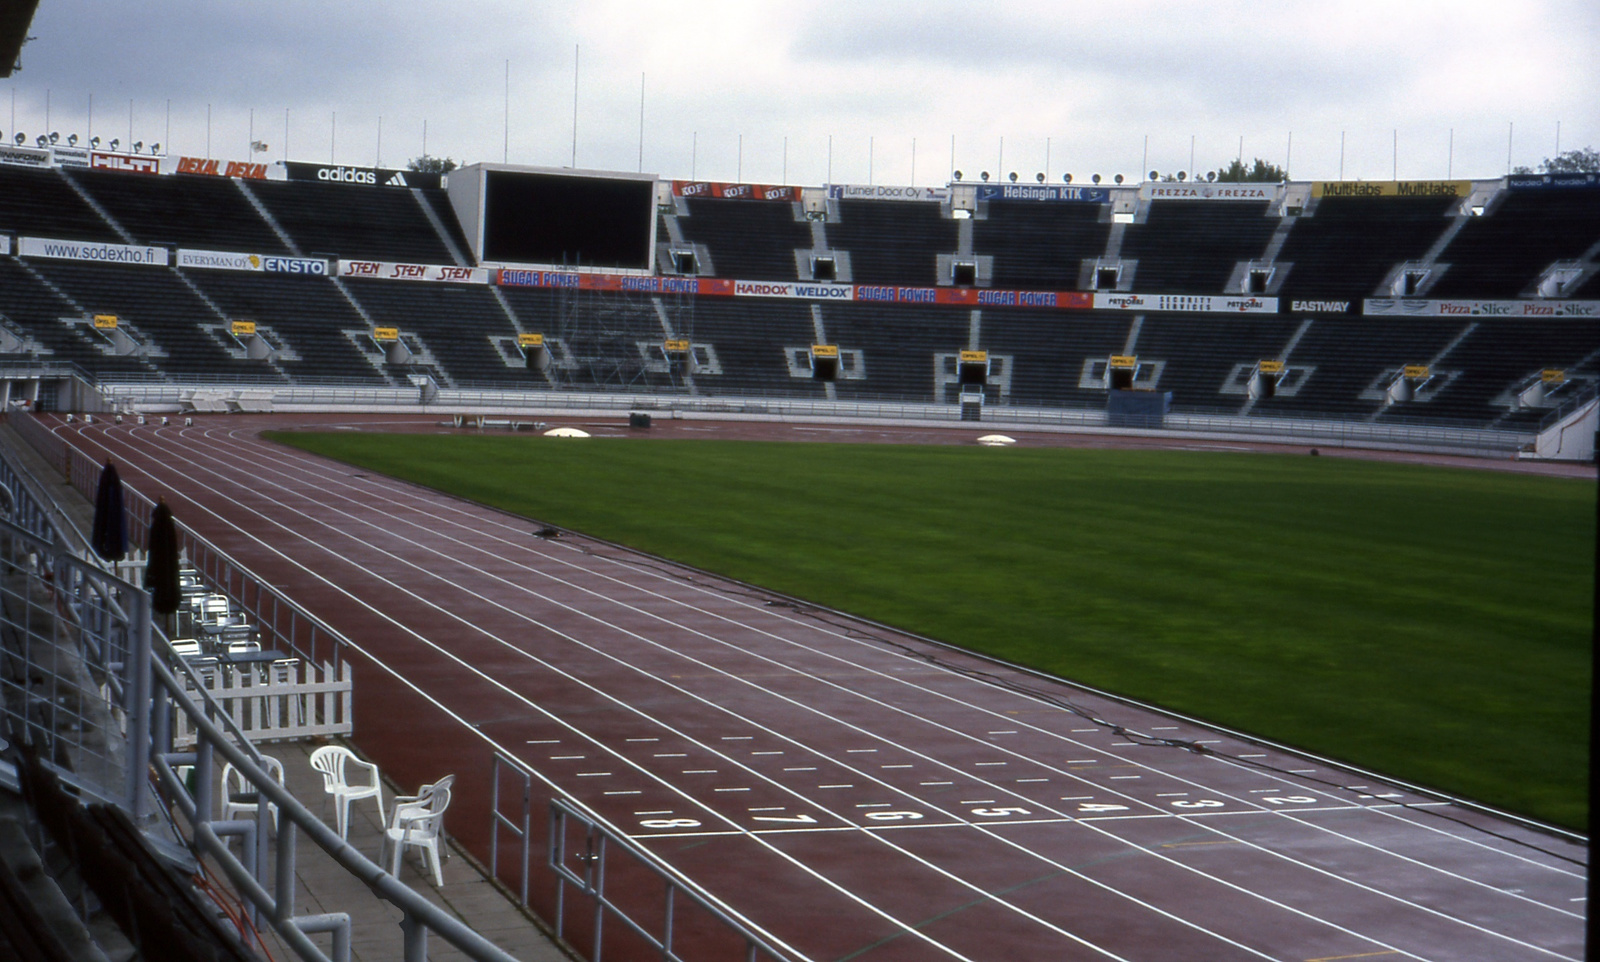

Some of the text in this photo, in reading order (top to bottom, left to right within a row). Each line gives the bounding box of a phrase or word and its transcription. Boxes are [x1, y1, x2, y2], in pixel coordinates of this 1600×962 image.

[93, 155, 158, 172] HILTI
[176, 156, 268, 180] DEXAL DEXAL
[318, 167, 376, 184] adidas
[845, 184, 875, 195] Turner
[877, 186, 903, 196] Door
[905, 187, 921, 198] Oy
[1003, 186, 1057, 201] Helsingin
[1060, 187, 1083, 199] KTK
[1151, 188, 1198, 197] FREZZA
[1217, 188, 1265, 198] FREZZA
[1323, 182, 1382, 196] Multi-tabs
[1397, 181, 1457, 195] Multi-tabs
[44, 242, 154, 263] www.sodexho.fi
[182, 254, 233, 268] EVERYMAN
[265, 258, 324, 274] ENSTO
[345, 262, 472, 281] STEN STEN STEN
[502, 270, 540, 286] SUGAR
[543, 272, 580, 288] POWER
[621, 277, 658, 292] SUGAR
[662, 279, 699, 293] POWER
[858, 286, 895, 301] SUGAR
[899, 288, 936, 302] POWER
[977, 290, 1016, 305] SUGAR
[1019, 291, 1057, 306] POWER
[1291, 300, 1350, 312] EASTWAY
[1440, 303, 1471, 315] Pizza
[1481, 303, 1510, 315] Slice
[1523, 303, 1593, 315] Pizza Slice
[1171, 799, 1225, 809] 3
[1263, 795, 1318, 805] 2
[970, 806, 1031, 817] 5
[1078, 802, 1130, 813] 4
[752, 813, 818, 825] 7
[864, 810, 924, 821] 6
[639, 818, 702, 829] 8
